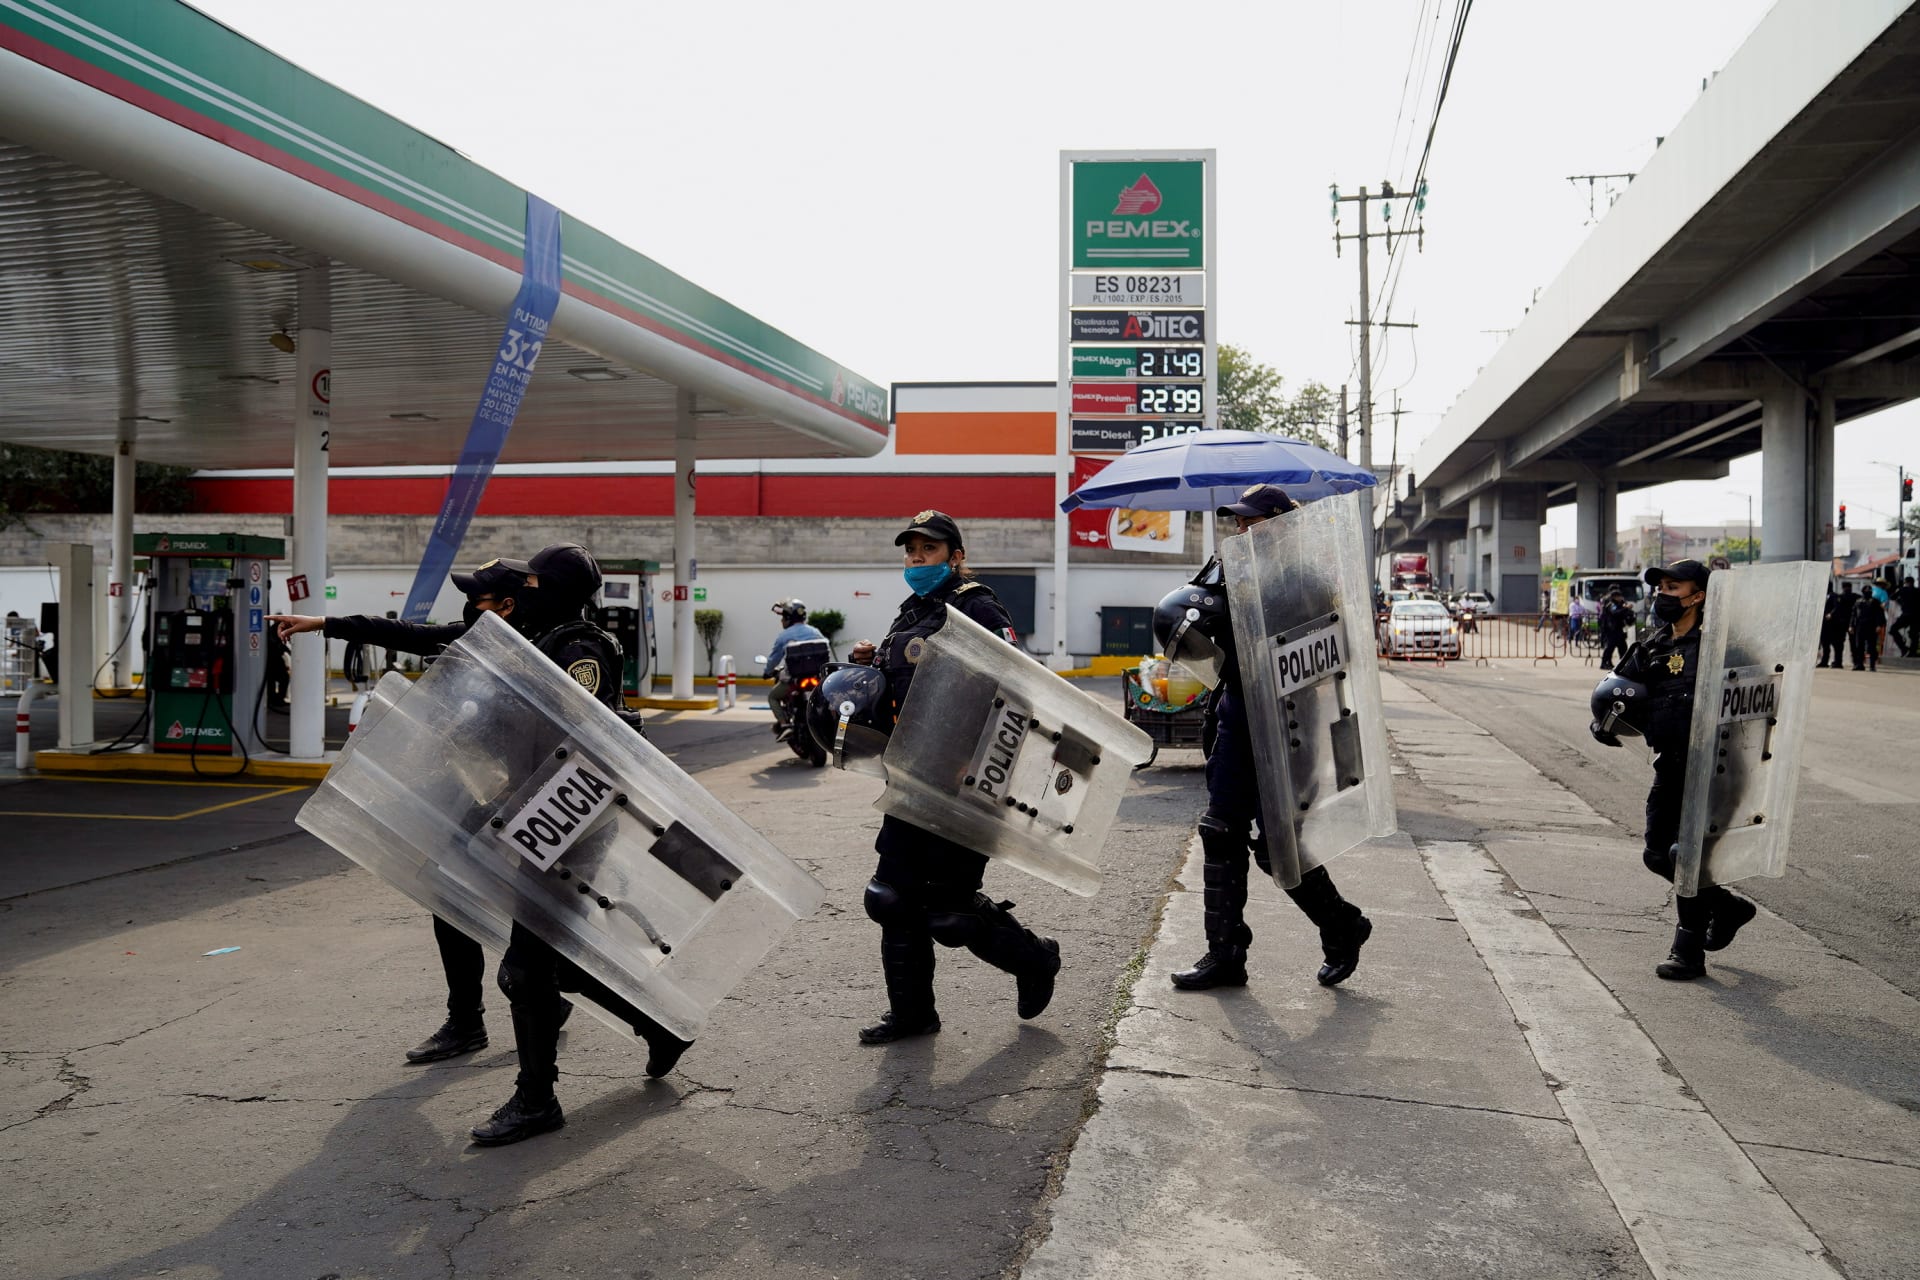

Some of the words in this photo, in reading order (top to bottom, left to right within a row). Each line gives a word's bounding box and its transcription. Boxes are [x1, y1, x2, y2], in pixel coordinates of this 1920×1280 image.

[1087, 220, 1190, 238] PEMEX
[1095, 276, 1119, 293] ES
[1126, 276, 1181, 293] 08231
[1099, 356, 1131, 367] Magna
[1096, 394, 1131, 402] Premium
[320, 431, 329, 451] 2
[1101, 430, 1131, 439] Diesel
[173, 541, 206, 549] PEMEX
[1278, 634, 1341, 689] POLICIA
[1721, 683, 1775, 718] POLICIA
[185, 727, 223, 736] PEMEX
[977, 710, 1029, 799] POLICIA
[512, 766, 613, 861] POLICIA
